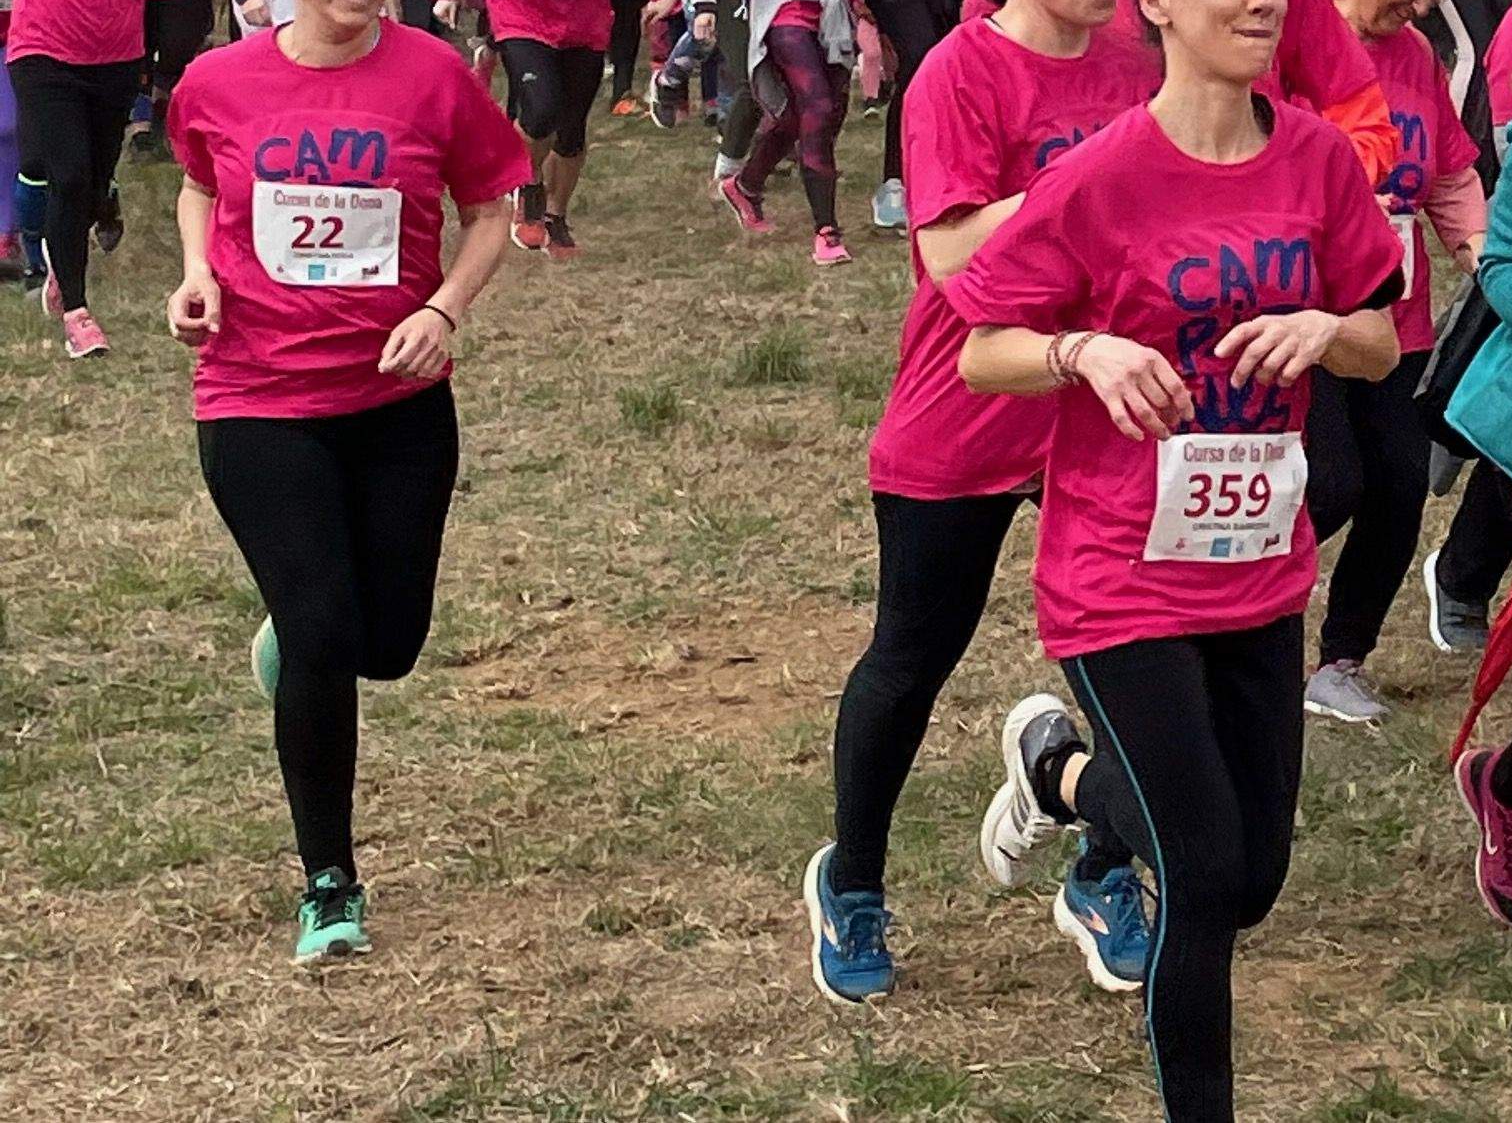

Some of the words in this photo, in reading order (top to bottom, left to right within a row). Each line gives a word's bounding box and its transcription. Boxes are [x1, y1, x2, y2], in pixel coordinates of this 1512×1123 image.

[291, 215, 345, 250] 22
[1184, 442, 1224, 462] Cursa
[1229, 442, 1246, 462] de
[1183, 472, 1272, 519] 359
